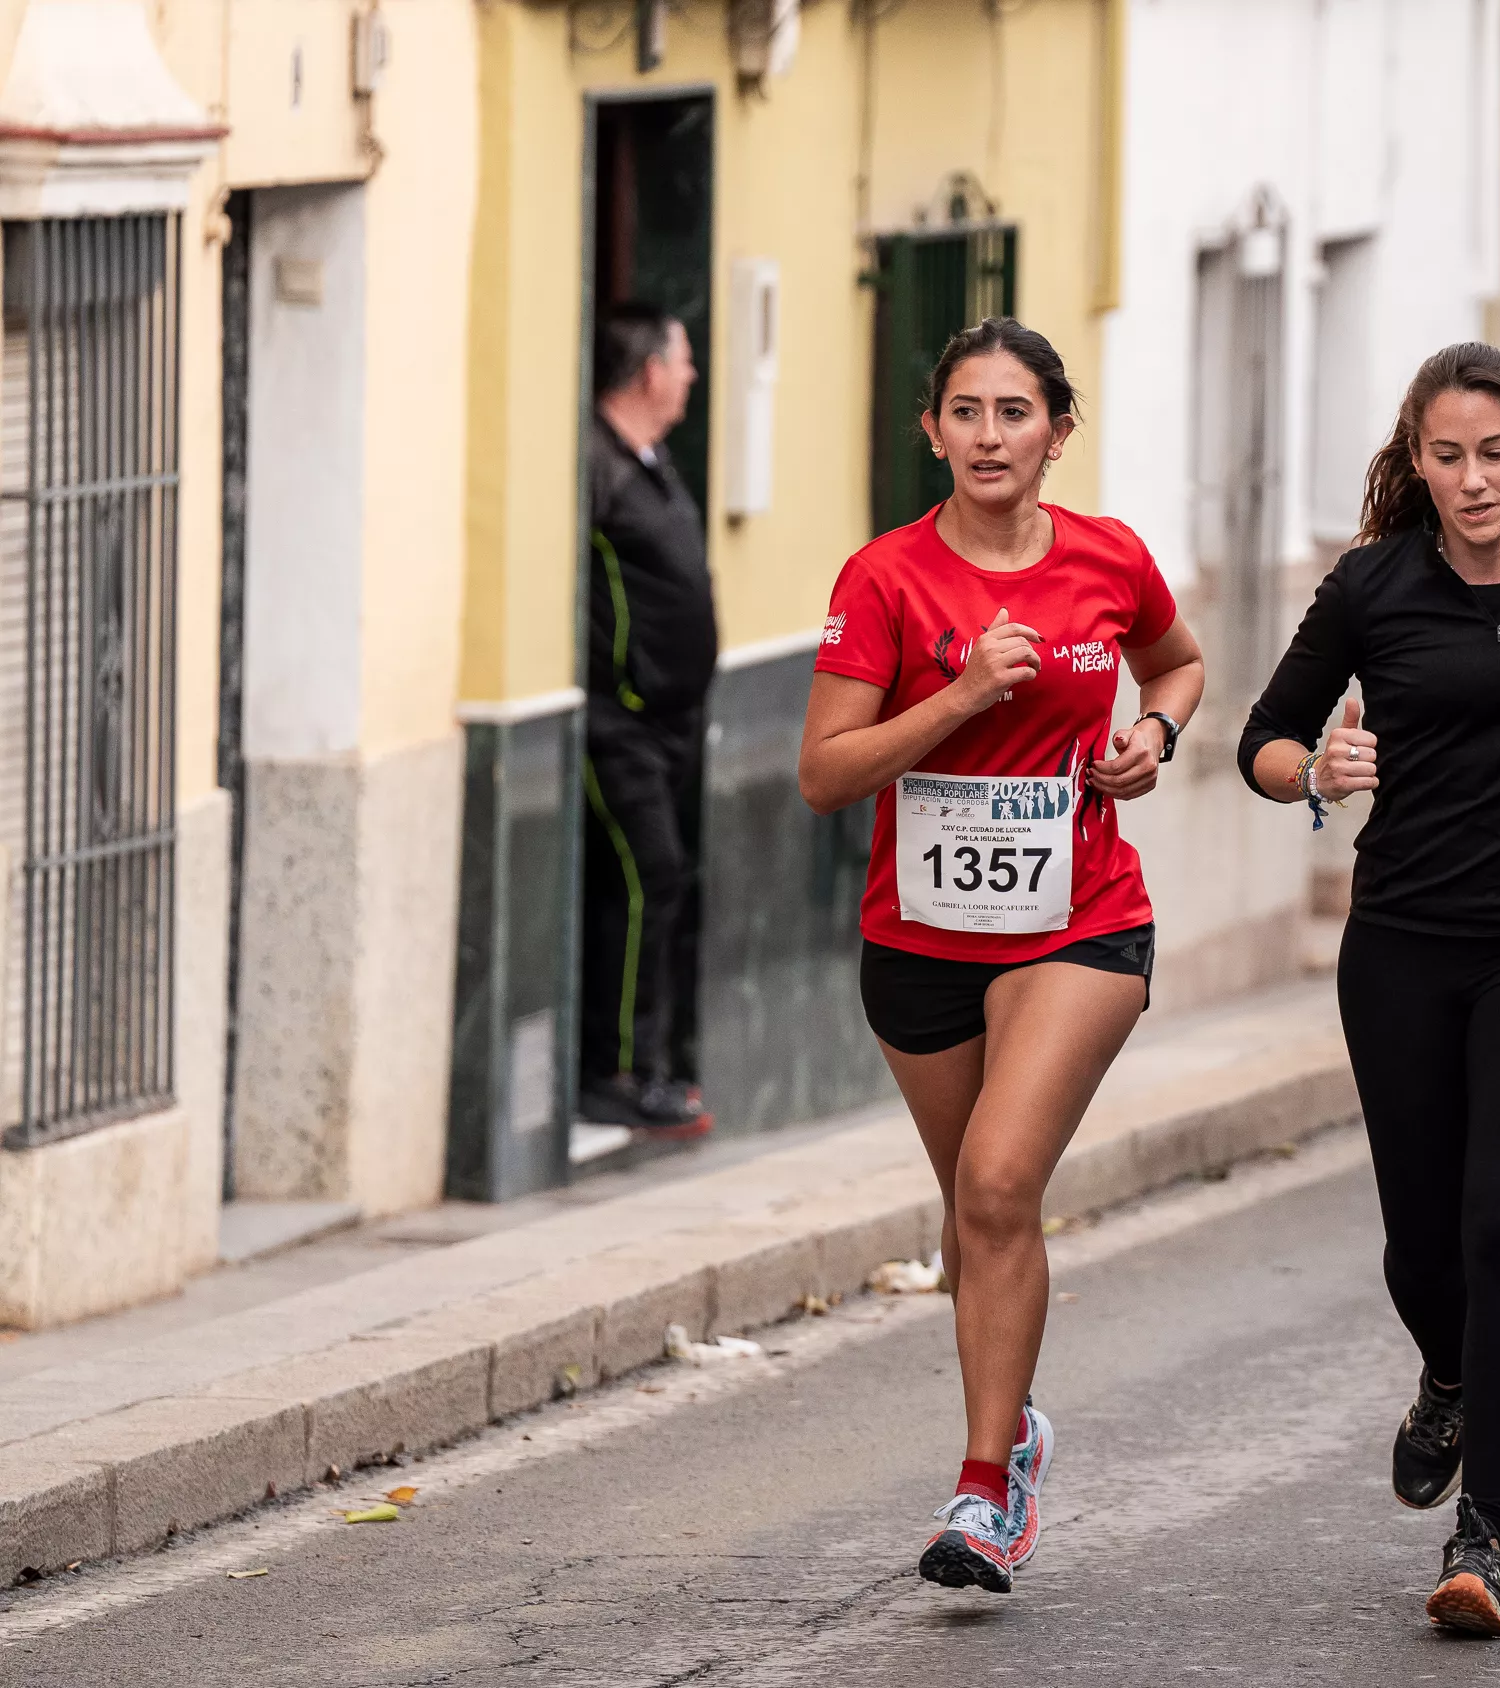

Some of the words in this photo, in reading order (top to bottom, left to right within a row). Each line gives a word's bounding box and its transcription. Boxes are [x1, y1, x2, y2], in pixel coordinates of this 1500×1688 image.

[1053, 645, 1070, 659] LA
[1071, 640, 1104, 657] MAREA
[1072, 651, 1115, 673] NEGRA
[902, 779, 934, 788] CIRCUITO
[936, 781, 977, 791] PROVINCIAL
[979, 783, 989, 791] DE
[902, 786, 942, 797] CARRERAS
[944, 789, 989, 799] POPULARES
[992, 782, 1035, 800] 2024
[941, 824, 955, 832] XXV
[923, 844, 1052, 892] 1357
[932, 901, 967, 910] GABRIELA
